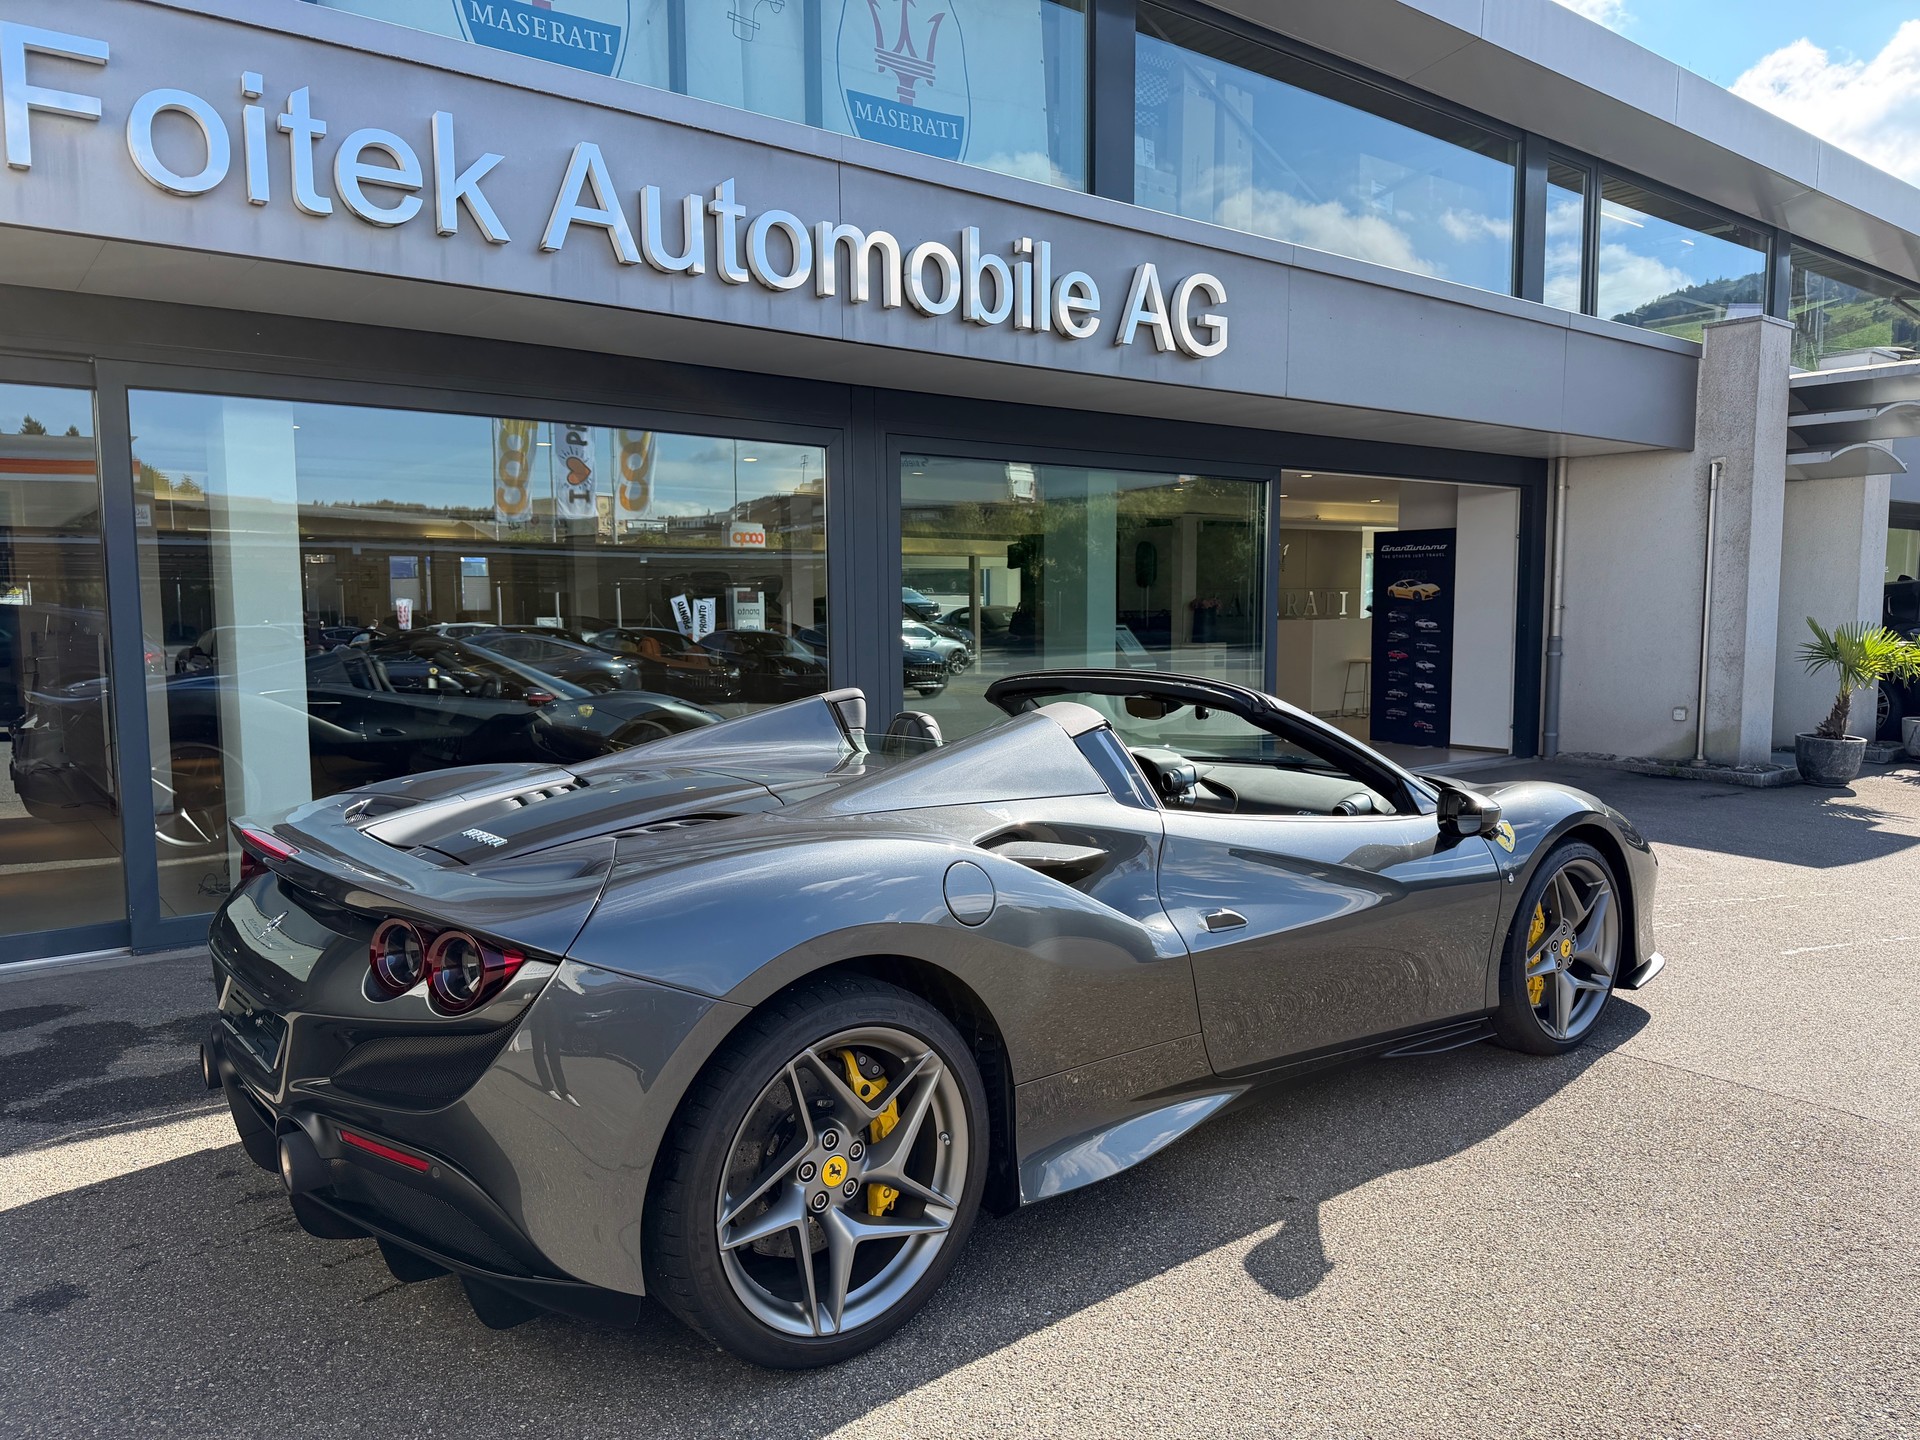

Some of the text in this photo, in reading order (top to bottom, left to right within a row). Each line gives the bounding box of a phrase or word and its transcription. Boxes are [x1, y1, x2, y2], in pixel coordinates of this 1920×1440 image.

[470, 1, 613, 56] MASERATI
[855, 100, 960, 141] MASERATI
[0, 20, 1229, 360] Foitek Automobile AG
